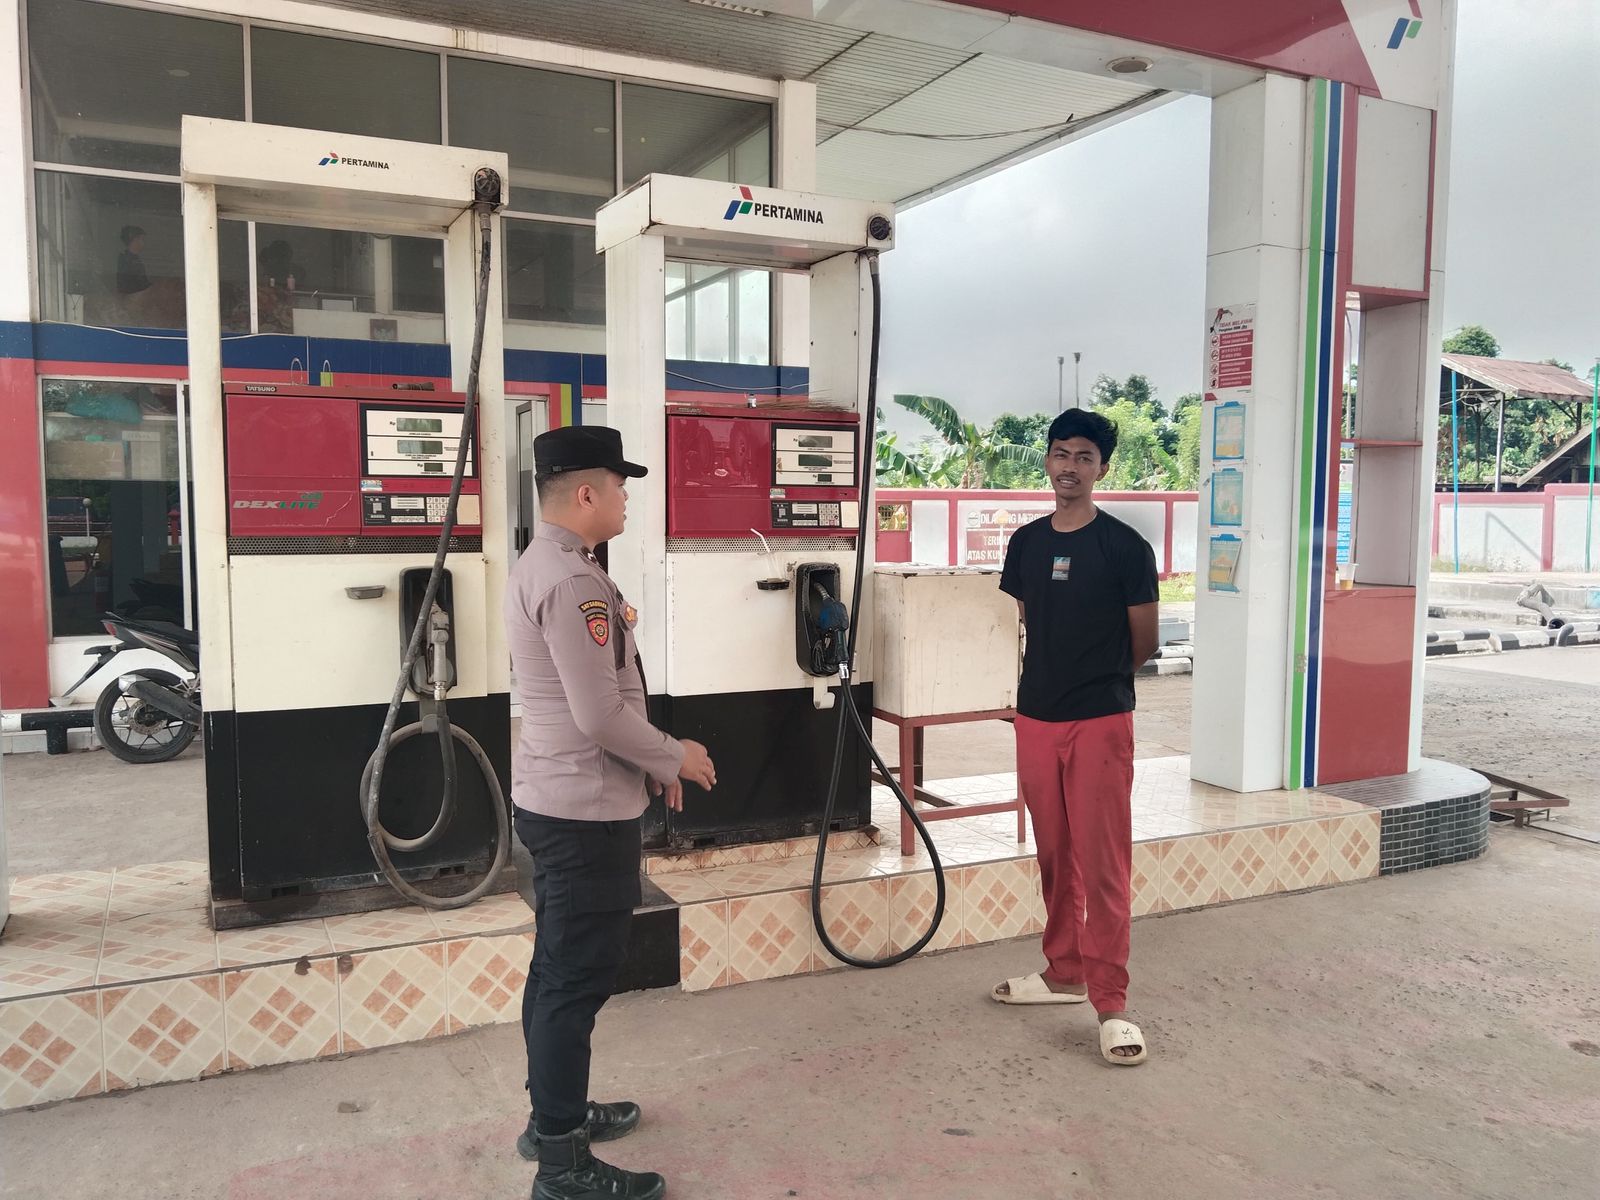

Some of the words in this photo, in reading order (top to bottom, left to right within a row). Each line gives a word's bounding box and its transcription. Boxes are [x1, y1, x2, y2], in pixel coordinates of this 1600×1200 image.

[341, 157, 390, 170] PERTAMINA
[754, 203, 824, 224] PERTAMINA
[232, 500, 320, 509] DEXLITE
[980, 513, 1016, 524] DILAG
[967, 550, 986, 561] ATAS
